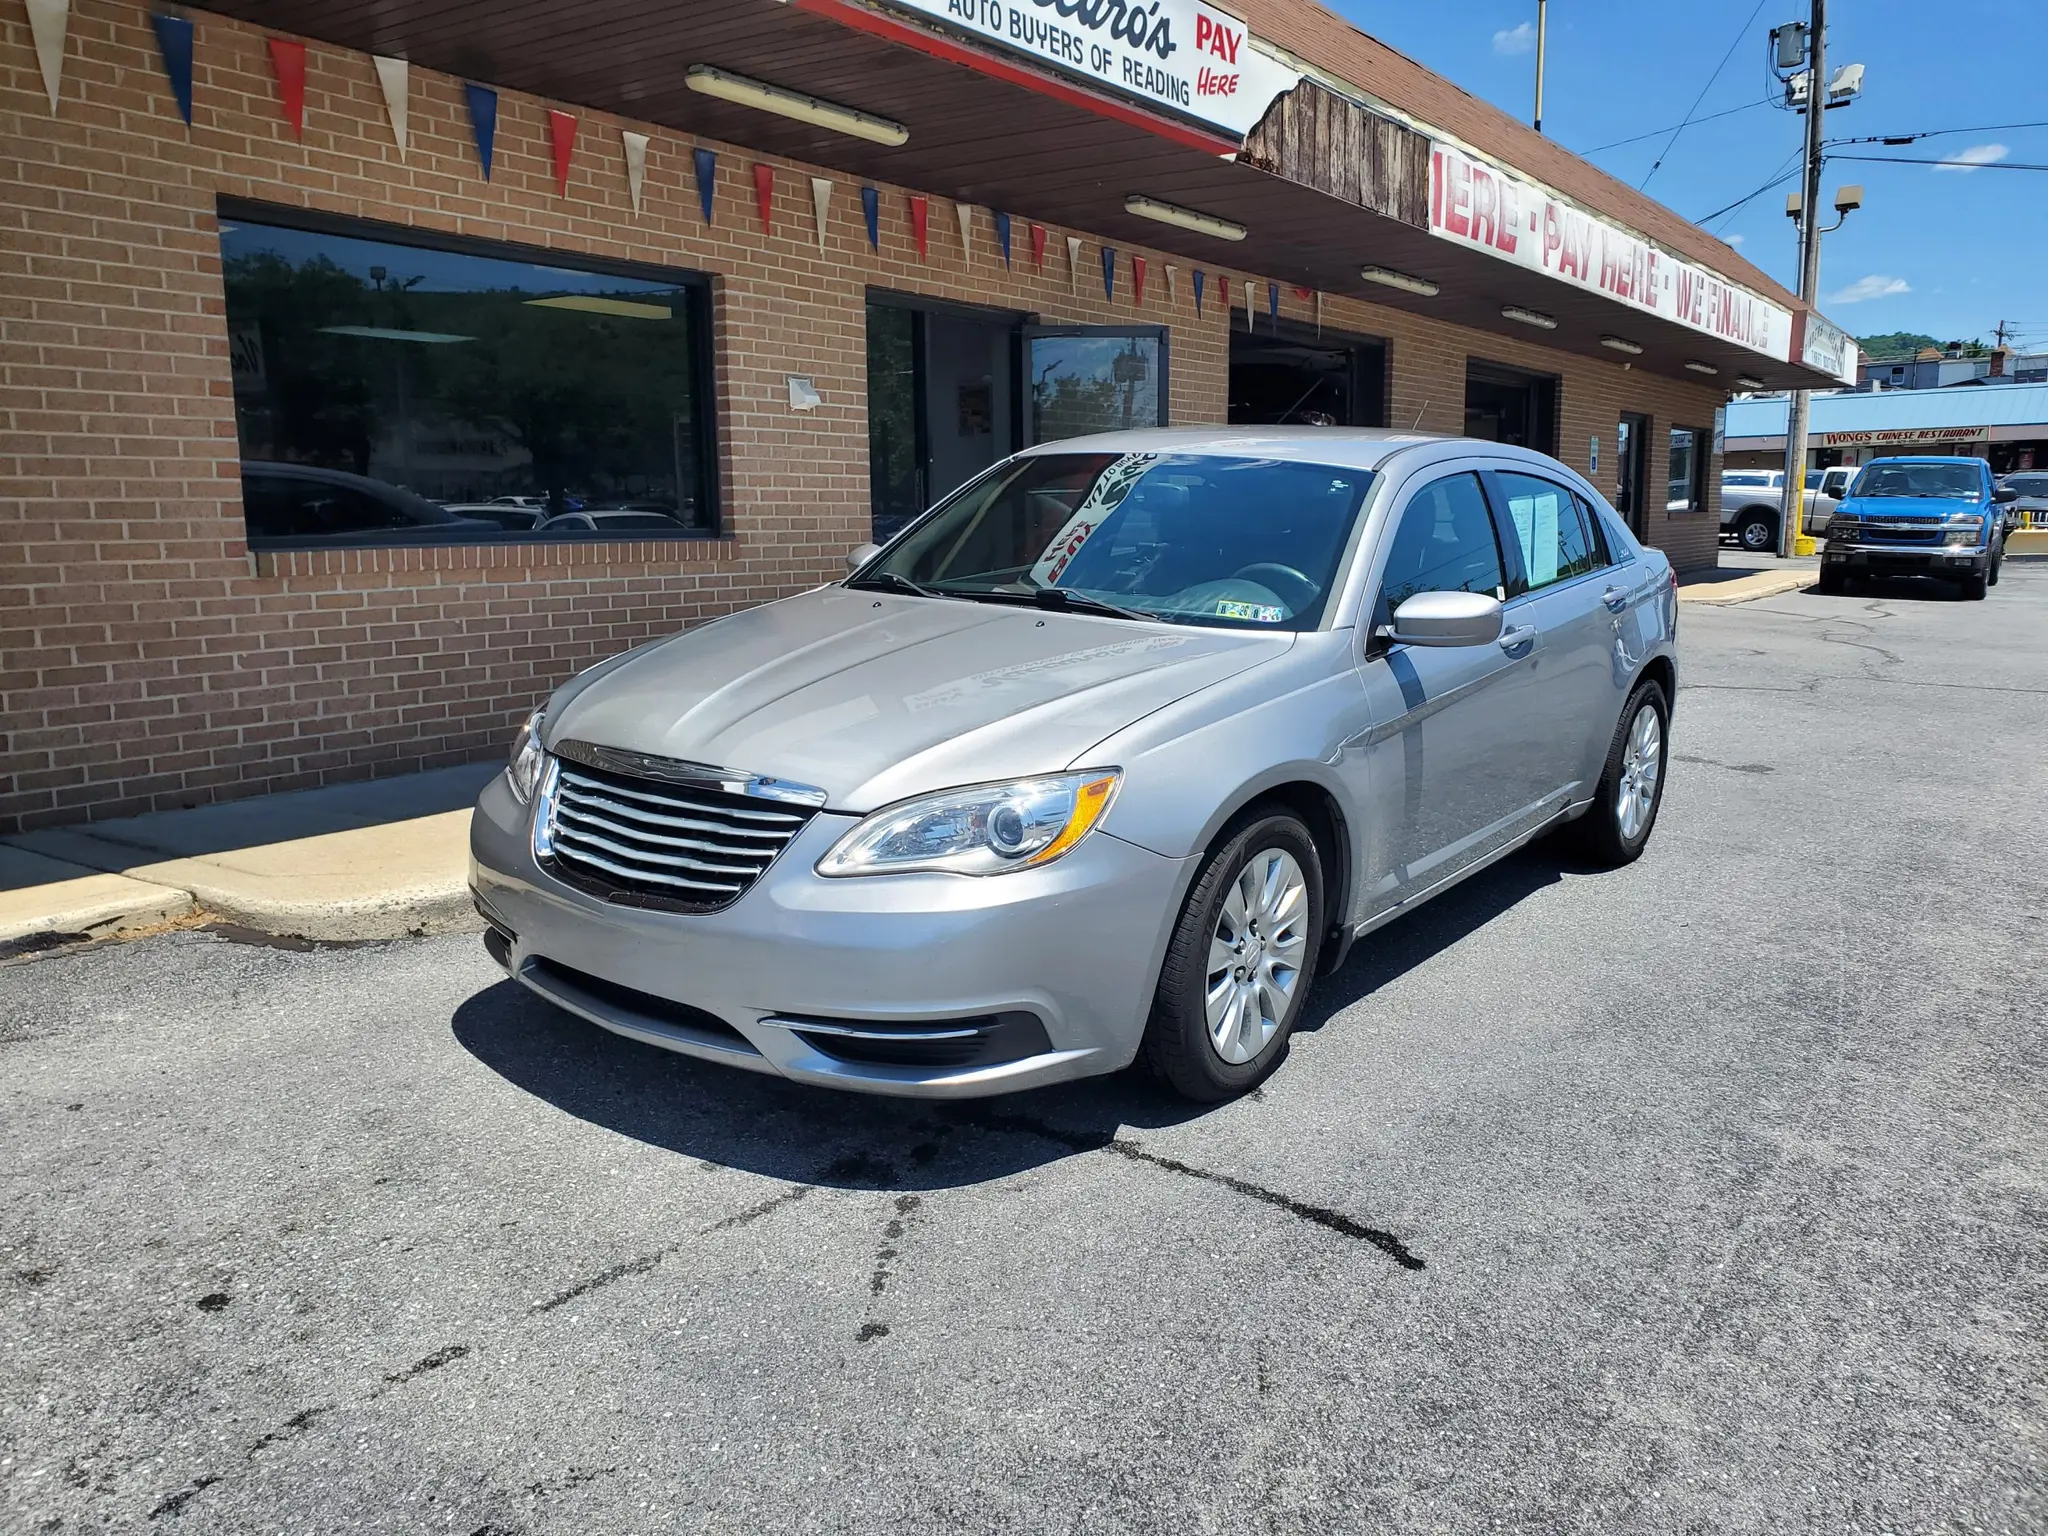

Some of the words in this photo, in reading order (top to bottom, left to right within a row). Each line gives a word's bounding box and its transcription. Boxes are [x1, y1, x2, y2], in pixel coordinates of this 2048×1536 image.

[948, 0, 1002, 31] AUTO
[1009, 8, 1083, 64] BUYERS
[1090, 43, 1113, 75] OF
[1122, 56, 1190, 106] READING
[1195, 12, 1242, 65] PAY
[1196, 66, 1240, 97] HERE
[1542, 201, 1595, 282] PAY
[1599, 229, 1660, 308] HERE
[1826, 431, 1872, 445] WONG'S
[1876, 430, 1916, 441] CHINESE
[1917, 427, 1986, 440] RESTAURANT
